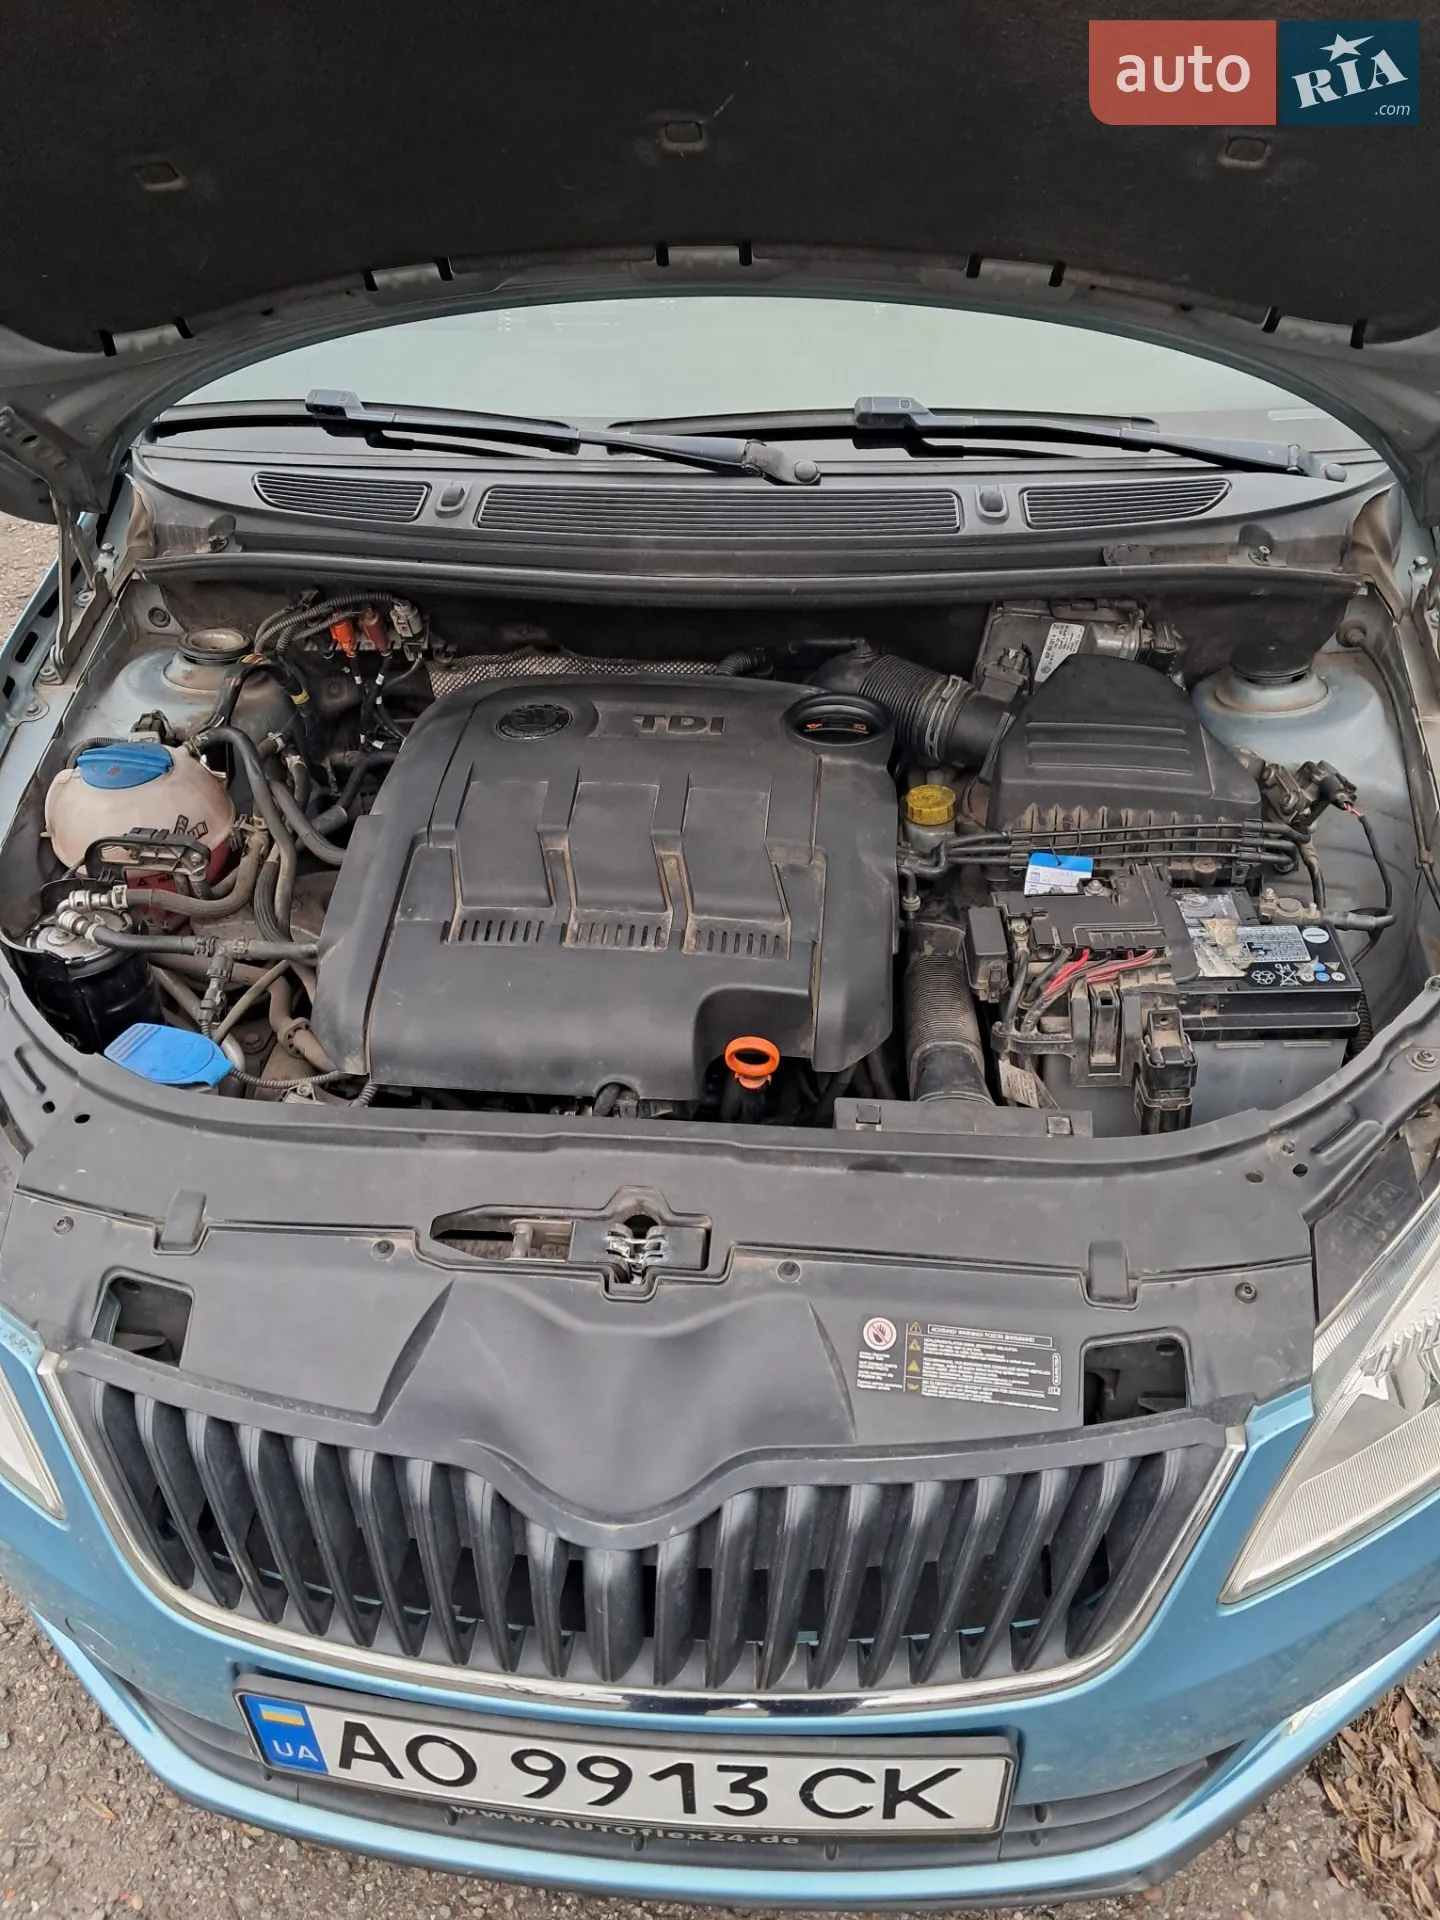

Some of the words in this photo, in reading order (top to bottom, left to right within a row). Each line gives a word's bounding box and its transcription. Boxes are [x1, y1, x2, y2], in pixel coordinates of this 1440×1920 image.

[632, 714, 725, 735] TDI
[272, 1739, 319, 1762] UA
[338, 1720, 478, 1787] AO
[510, 1748, 769, 1816] 9913
[799, 1767, 963, 1820] CK
